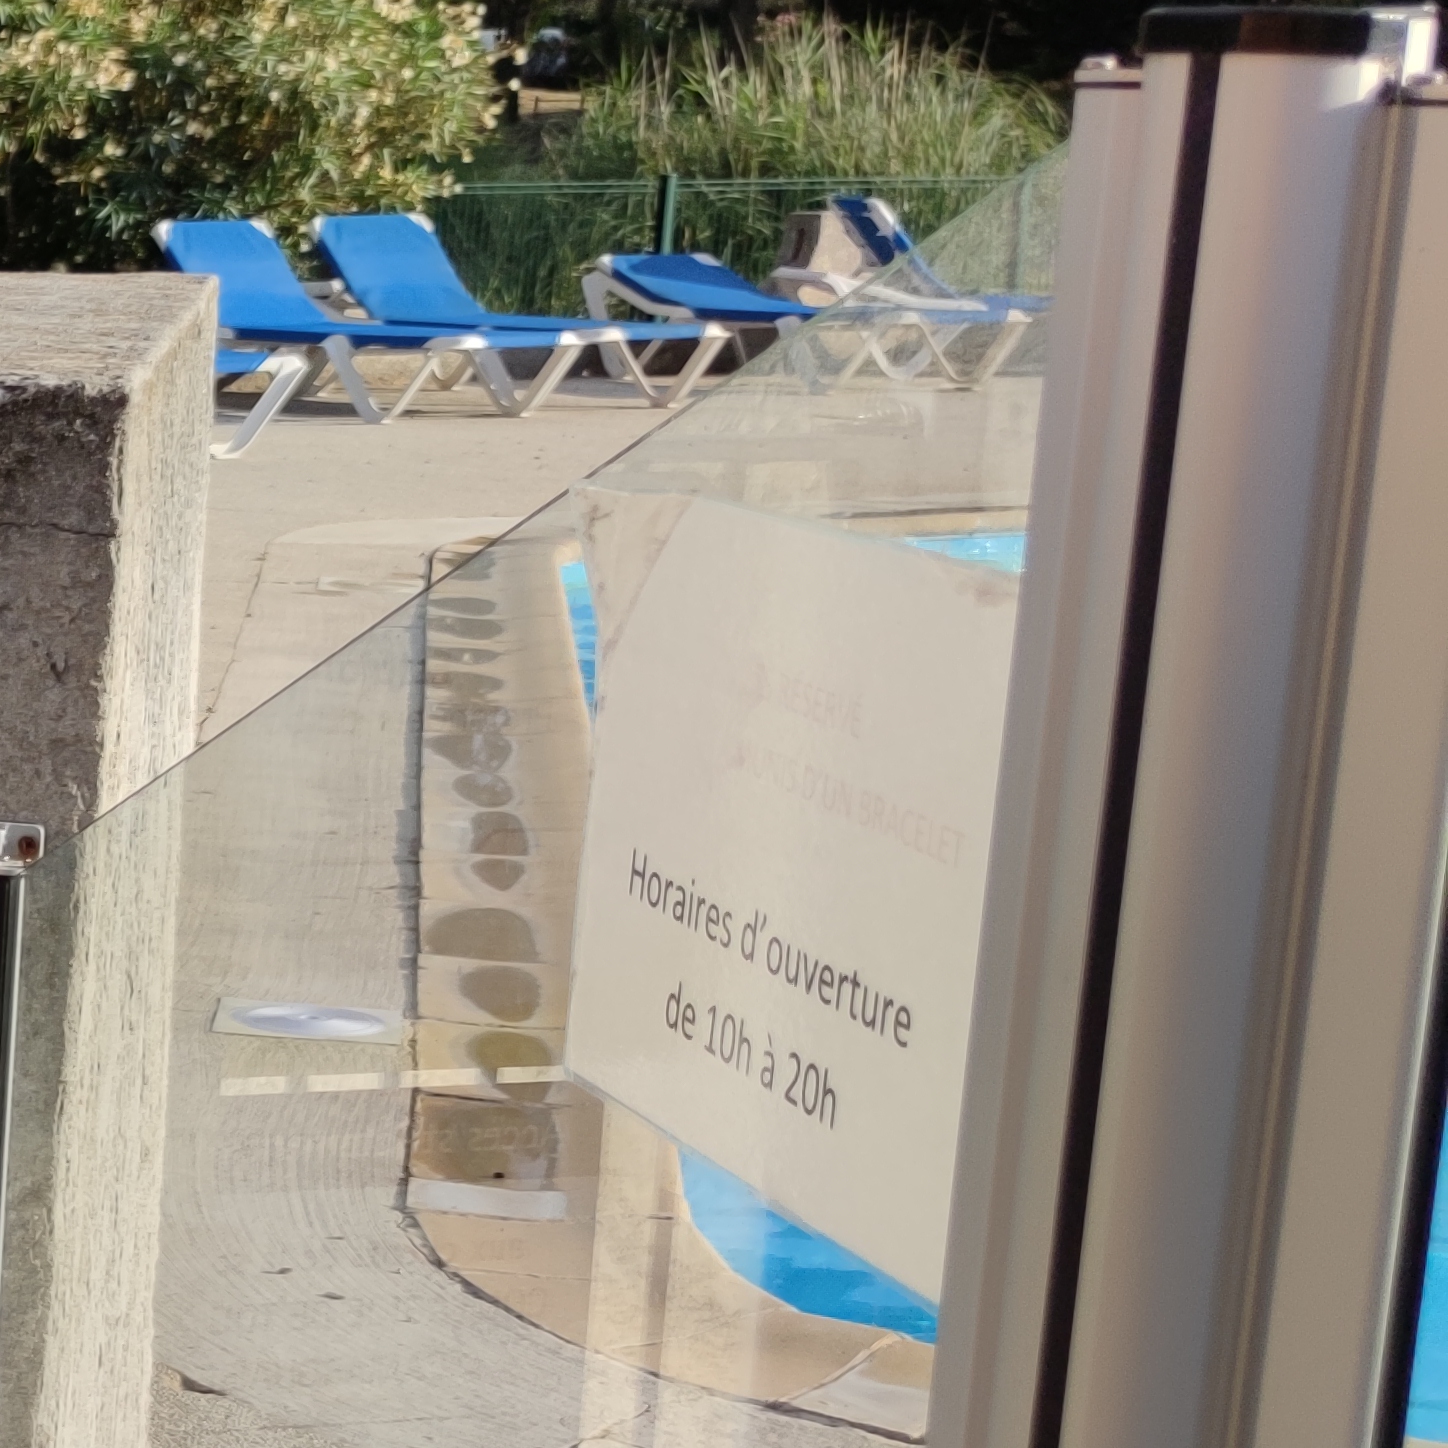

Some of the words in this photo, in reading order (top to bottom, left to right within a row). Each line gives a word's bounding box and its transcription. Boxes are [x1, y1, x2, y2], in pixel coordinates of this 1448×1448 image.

[858, 784, 967, 869] BRACELET
[629, 847, 732, 949] Horaires
[741, 909, 912, 1048] d'ouverture
[665, 981, 696, 1041] de
[703, 1005, 753, 1077] 10h
[760, 1032, 775, 1090] à
[784, 1052, 838, 1130] 20h
